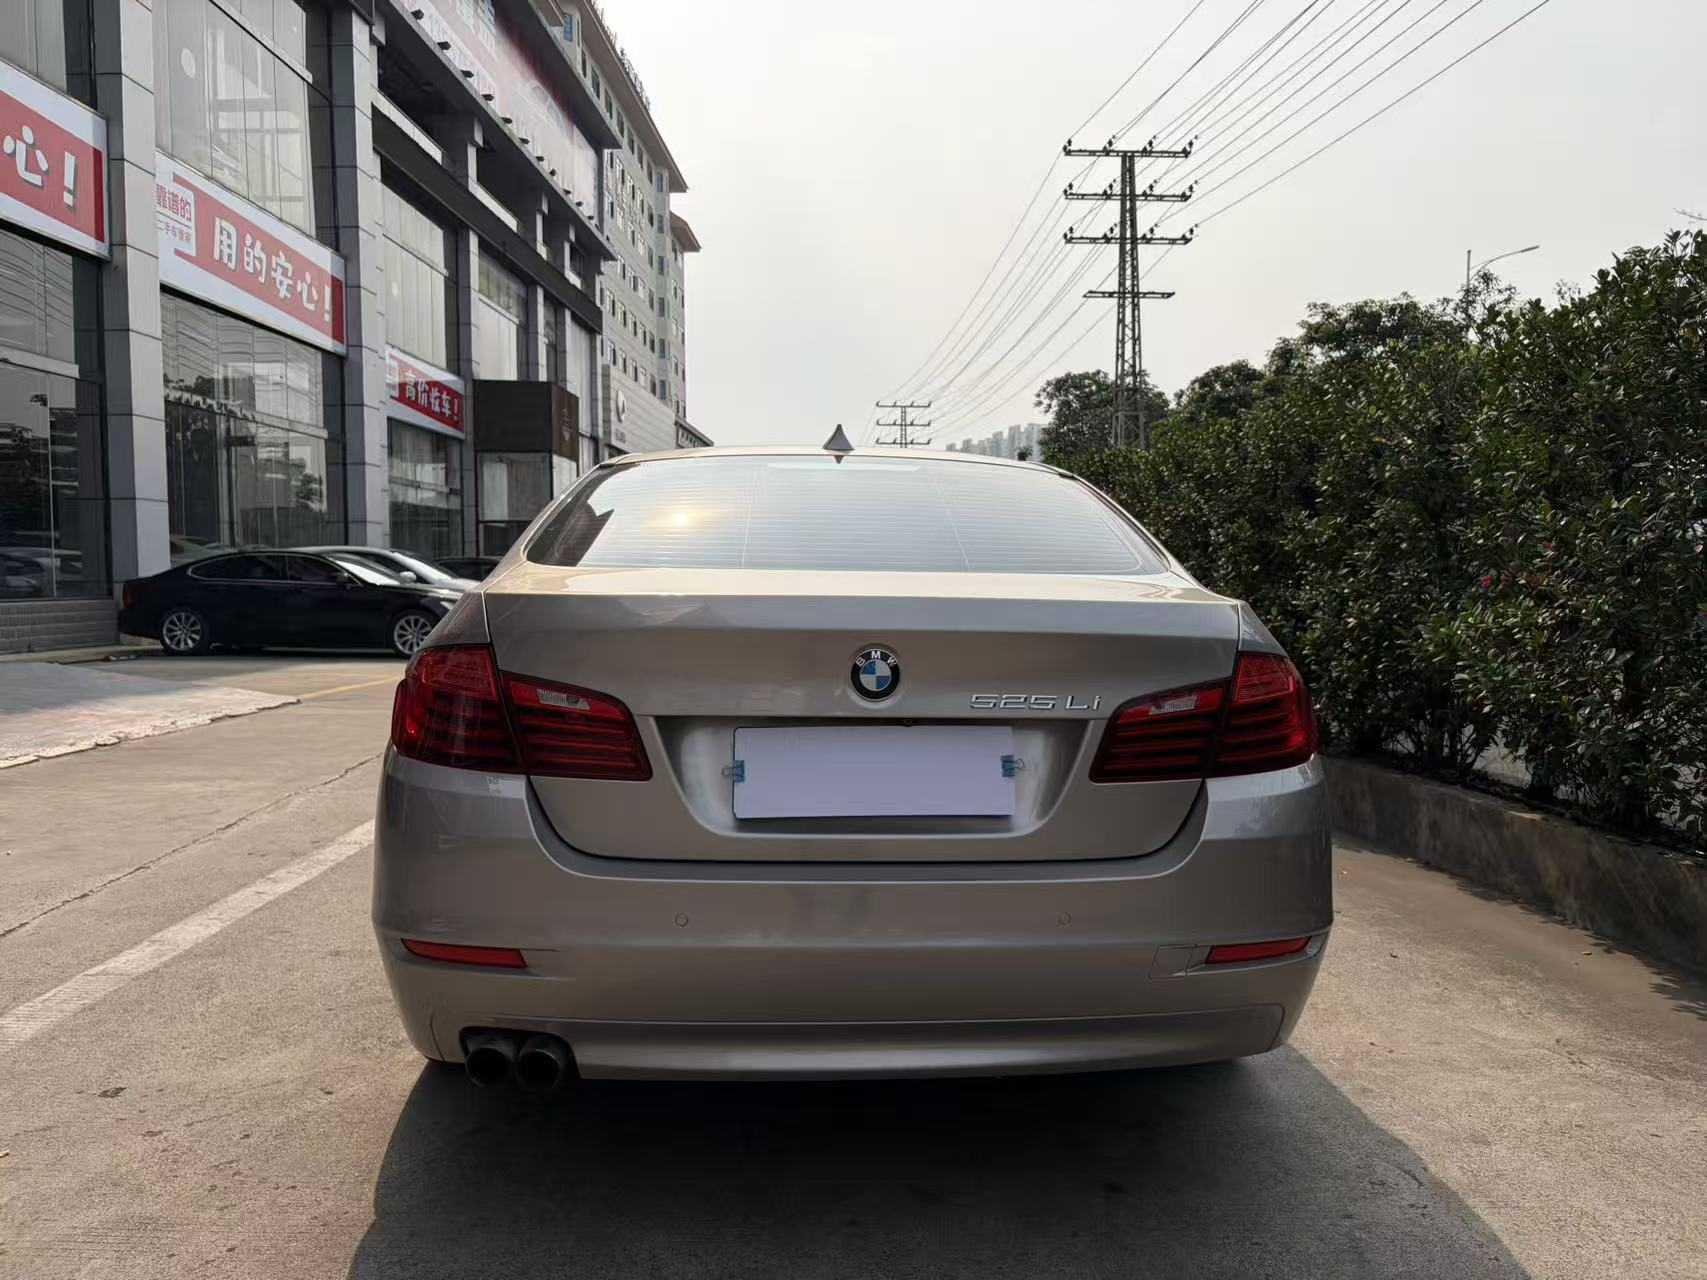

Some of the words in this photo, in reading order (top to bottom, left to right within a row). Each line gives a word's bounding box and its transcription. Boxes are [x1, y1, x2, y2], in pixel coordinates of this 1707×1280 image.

[213, 216, 331, 322] 用的安心!
[855, 650, 897, 667] BMW
